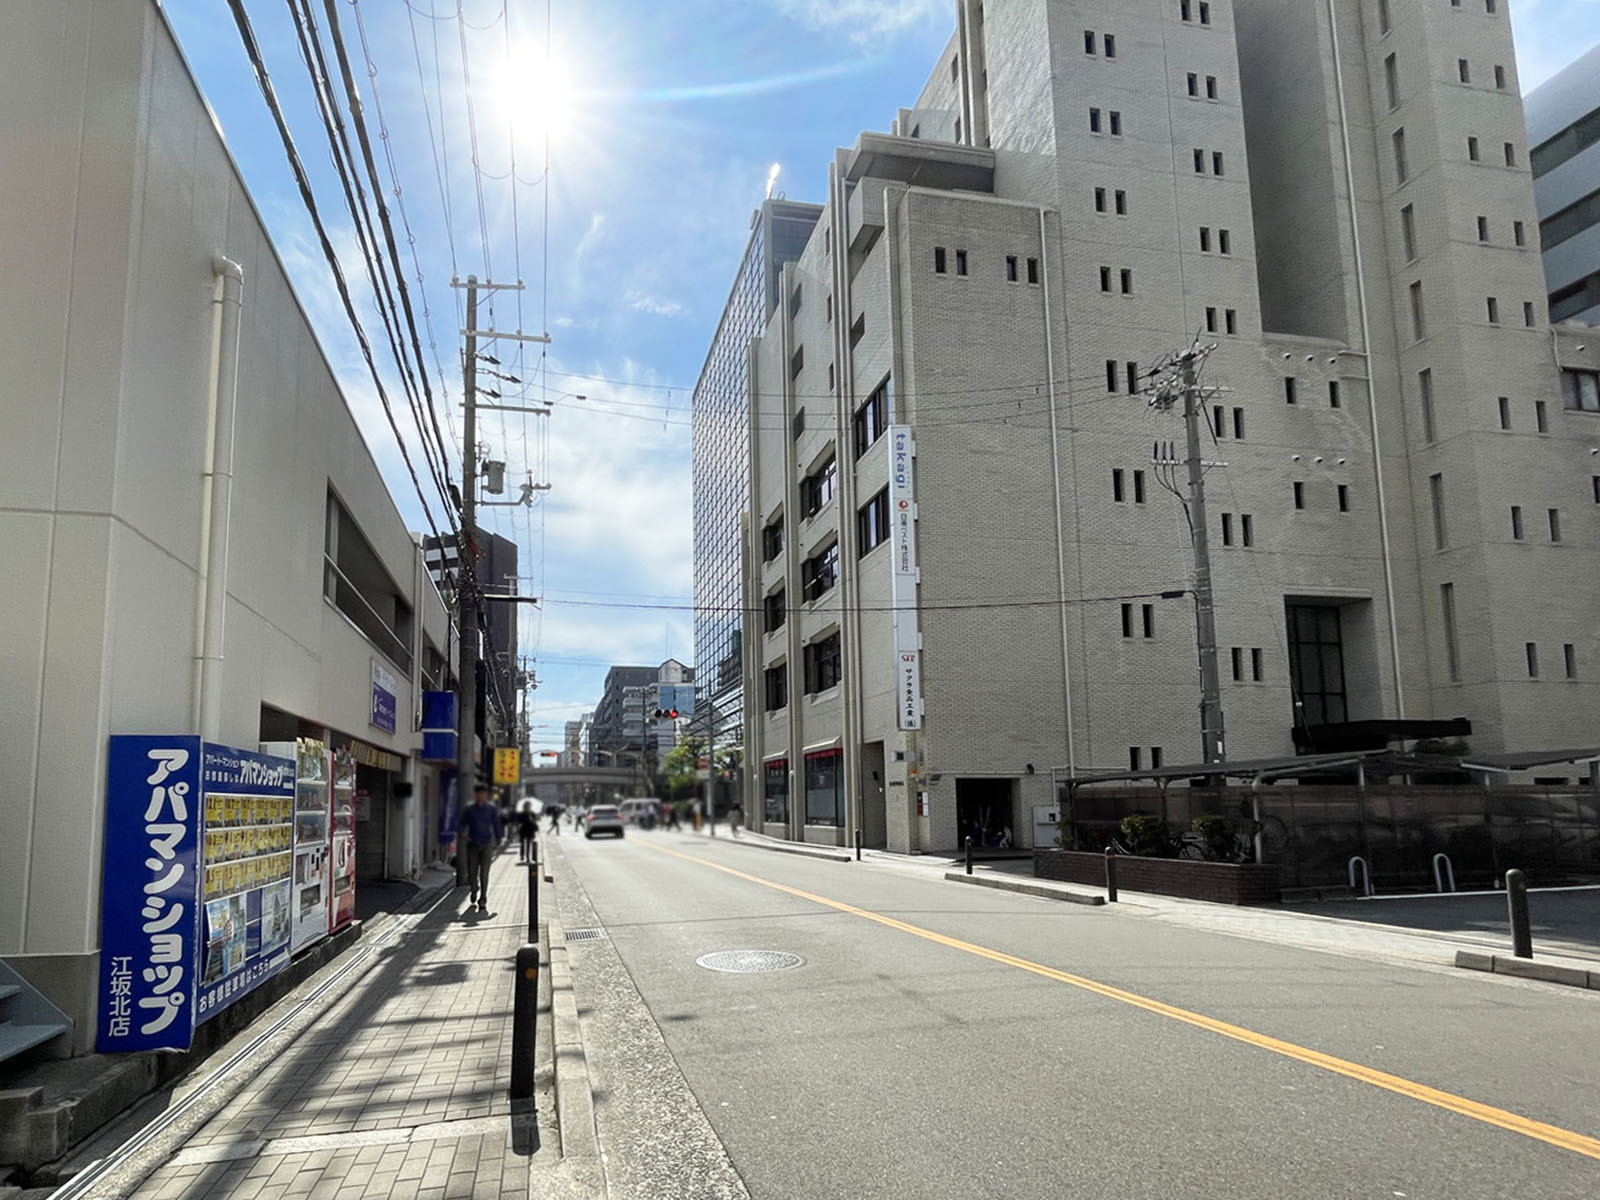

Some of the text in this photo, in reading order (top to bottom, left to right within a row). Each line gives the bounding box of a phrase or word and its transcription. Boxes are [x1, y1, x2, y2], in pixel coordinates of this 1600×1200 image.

[896, 433, 906, 489] takagi
[240, 758, 284, 788] アパマンショップ
[138, 749, 190, 1035] アパマンショップ
[108, 956, 133, 1038] 江坂北店
